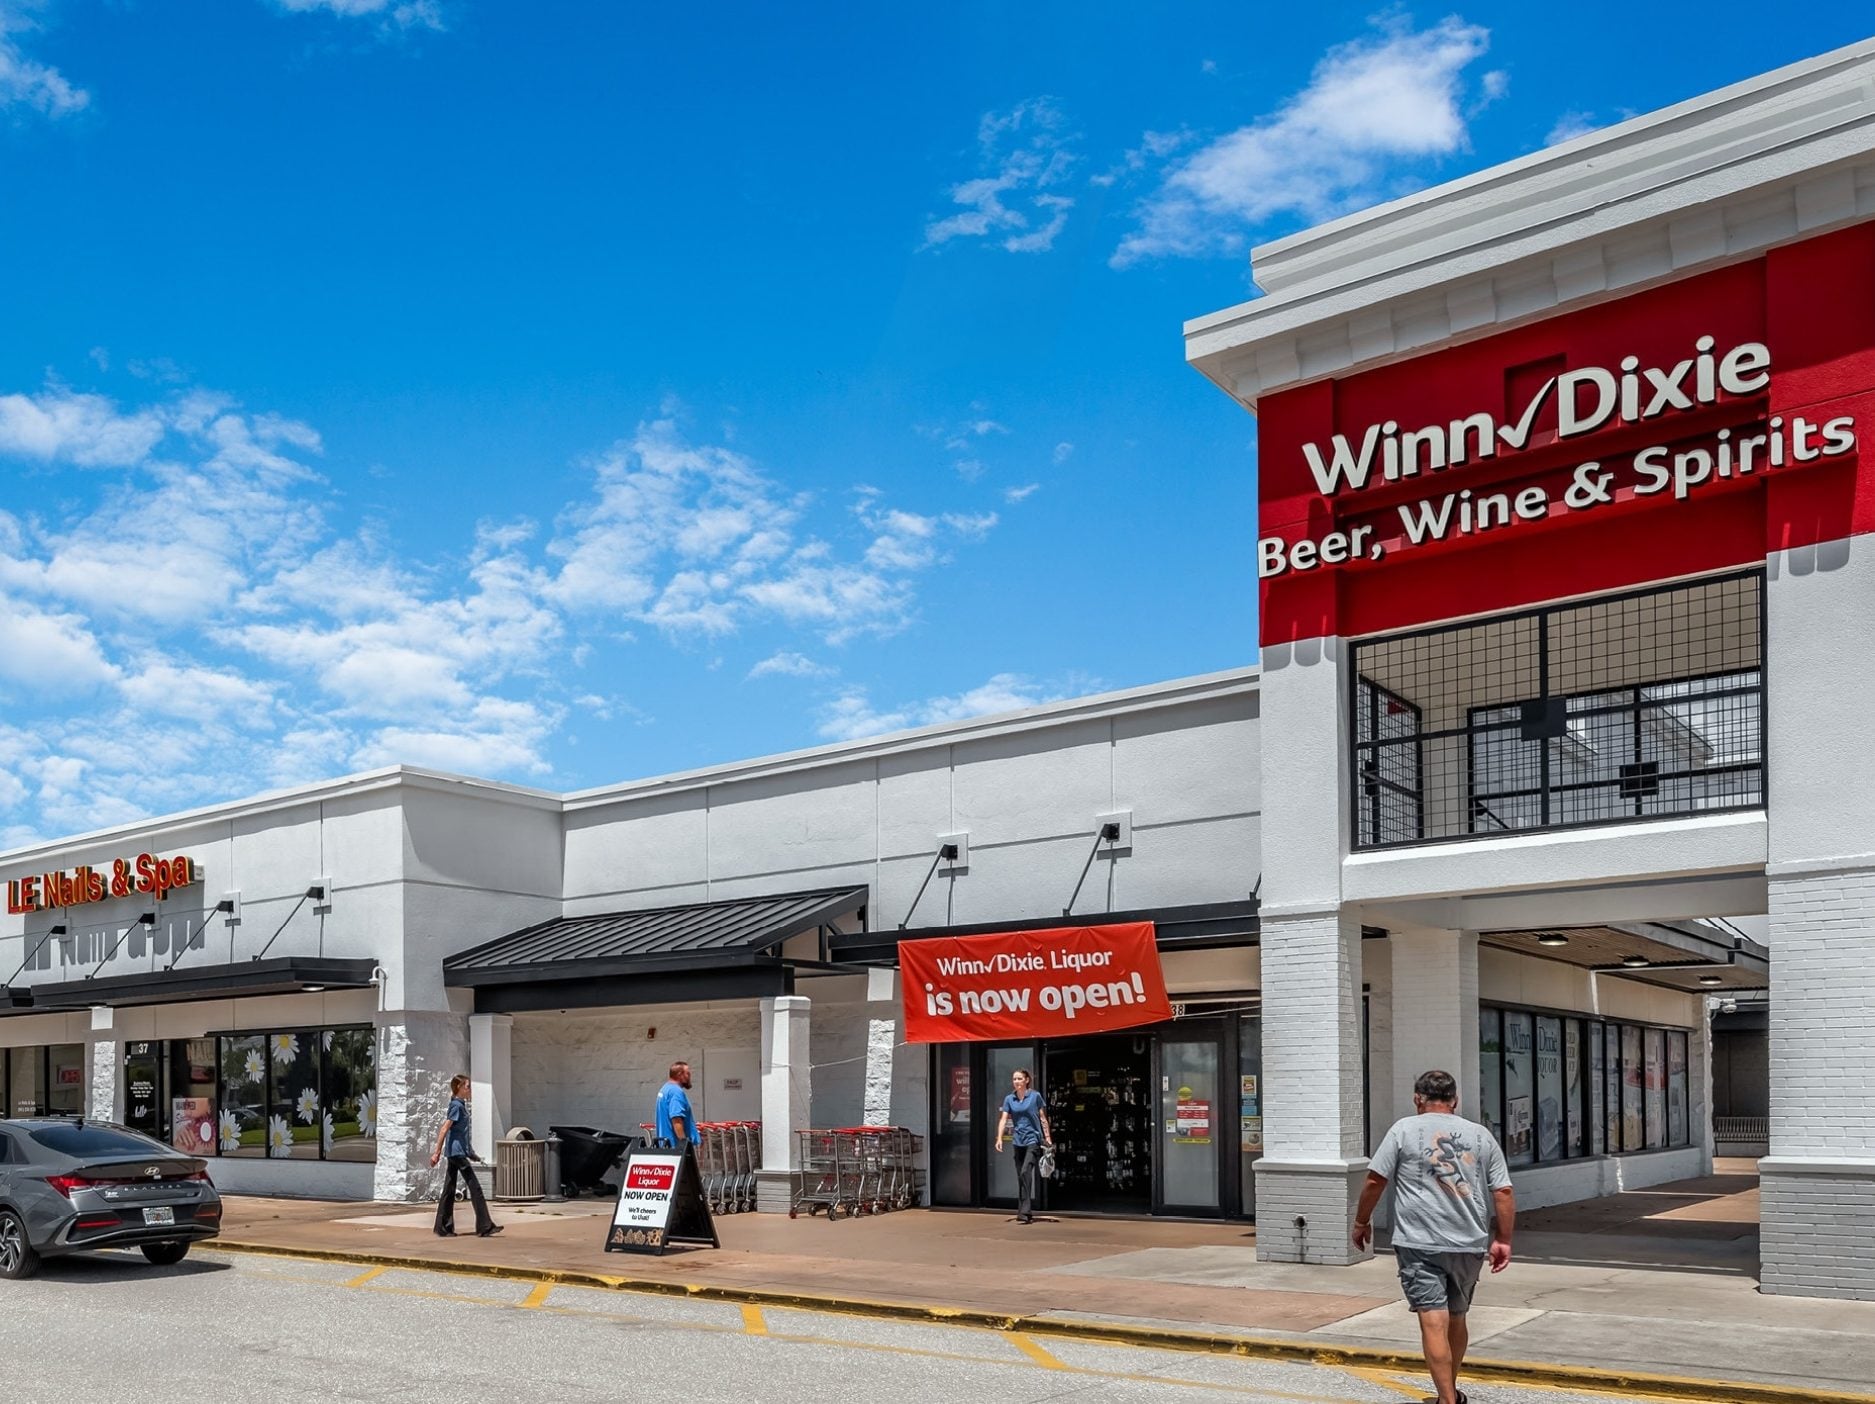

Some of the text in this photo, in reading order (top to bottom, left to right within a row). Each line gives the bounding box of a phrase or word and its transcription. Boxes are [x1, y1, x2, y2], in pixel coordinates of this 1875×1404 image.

[1302, 335, 1771, 495] Winn Dixie
[1258, 416, 1856, 578] Beer, Wine & Spirits
[8, 853, 193, 914] LE Nails & Spa
[937, 949, 1113, 976] Winn Dixie Liquor
[924, 972, 1147, 1019] is now open!
[1171, 1004, 1184, 1016] 38
[139, 1043, 149, 1054] 37
[1510, 1023, 1532, 1050] Winn
[632, 1166, 672, 1176] Winn Dixie
[638, 1177, 660, 1187] Liquor
[624, 1191, 668, 1201] NOW OPEN
